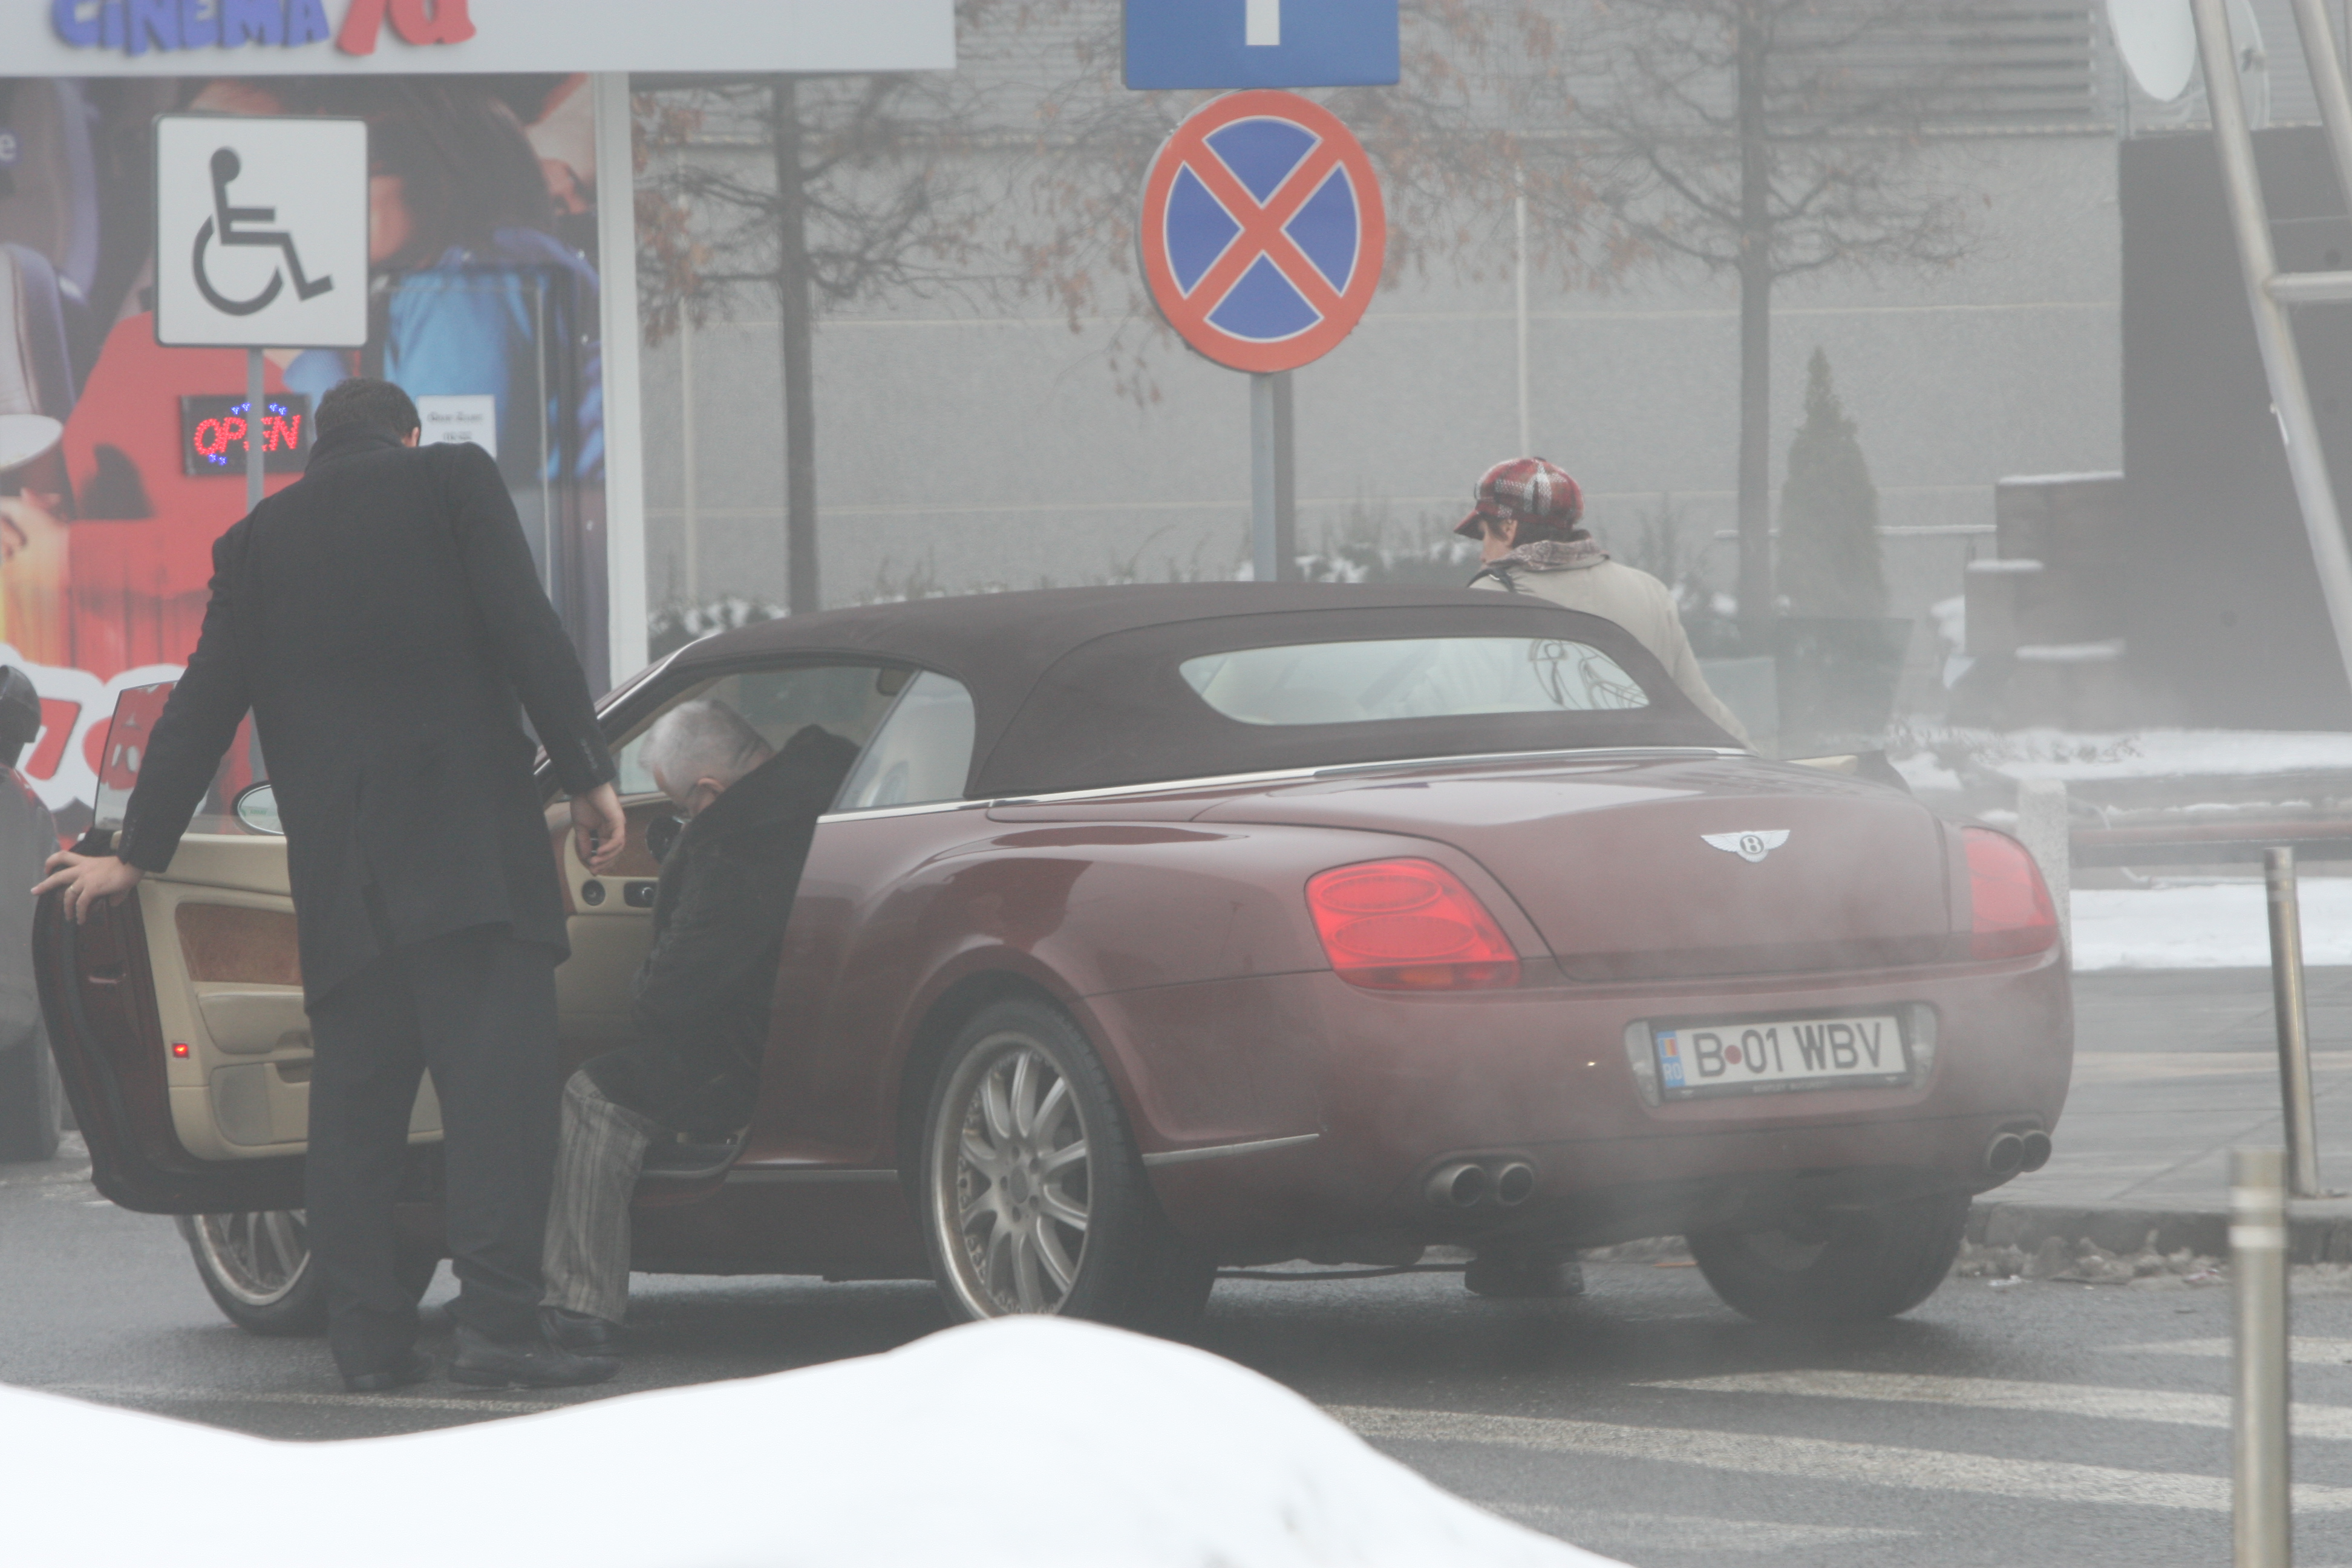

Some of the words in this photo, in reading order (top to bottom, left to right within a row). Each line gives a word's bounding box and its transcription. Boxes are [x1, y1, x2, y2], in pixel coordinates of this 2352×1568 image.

[1742, 835, 1762, 853] B
[1693, 1032, 1726, 1078] B
[1741, 1028, 1784, 1074] 01
[1792, 1021, 1881, 1071] WBV
[1663, 1062, 1683, 1080] RO
